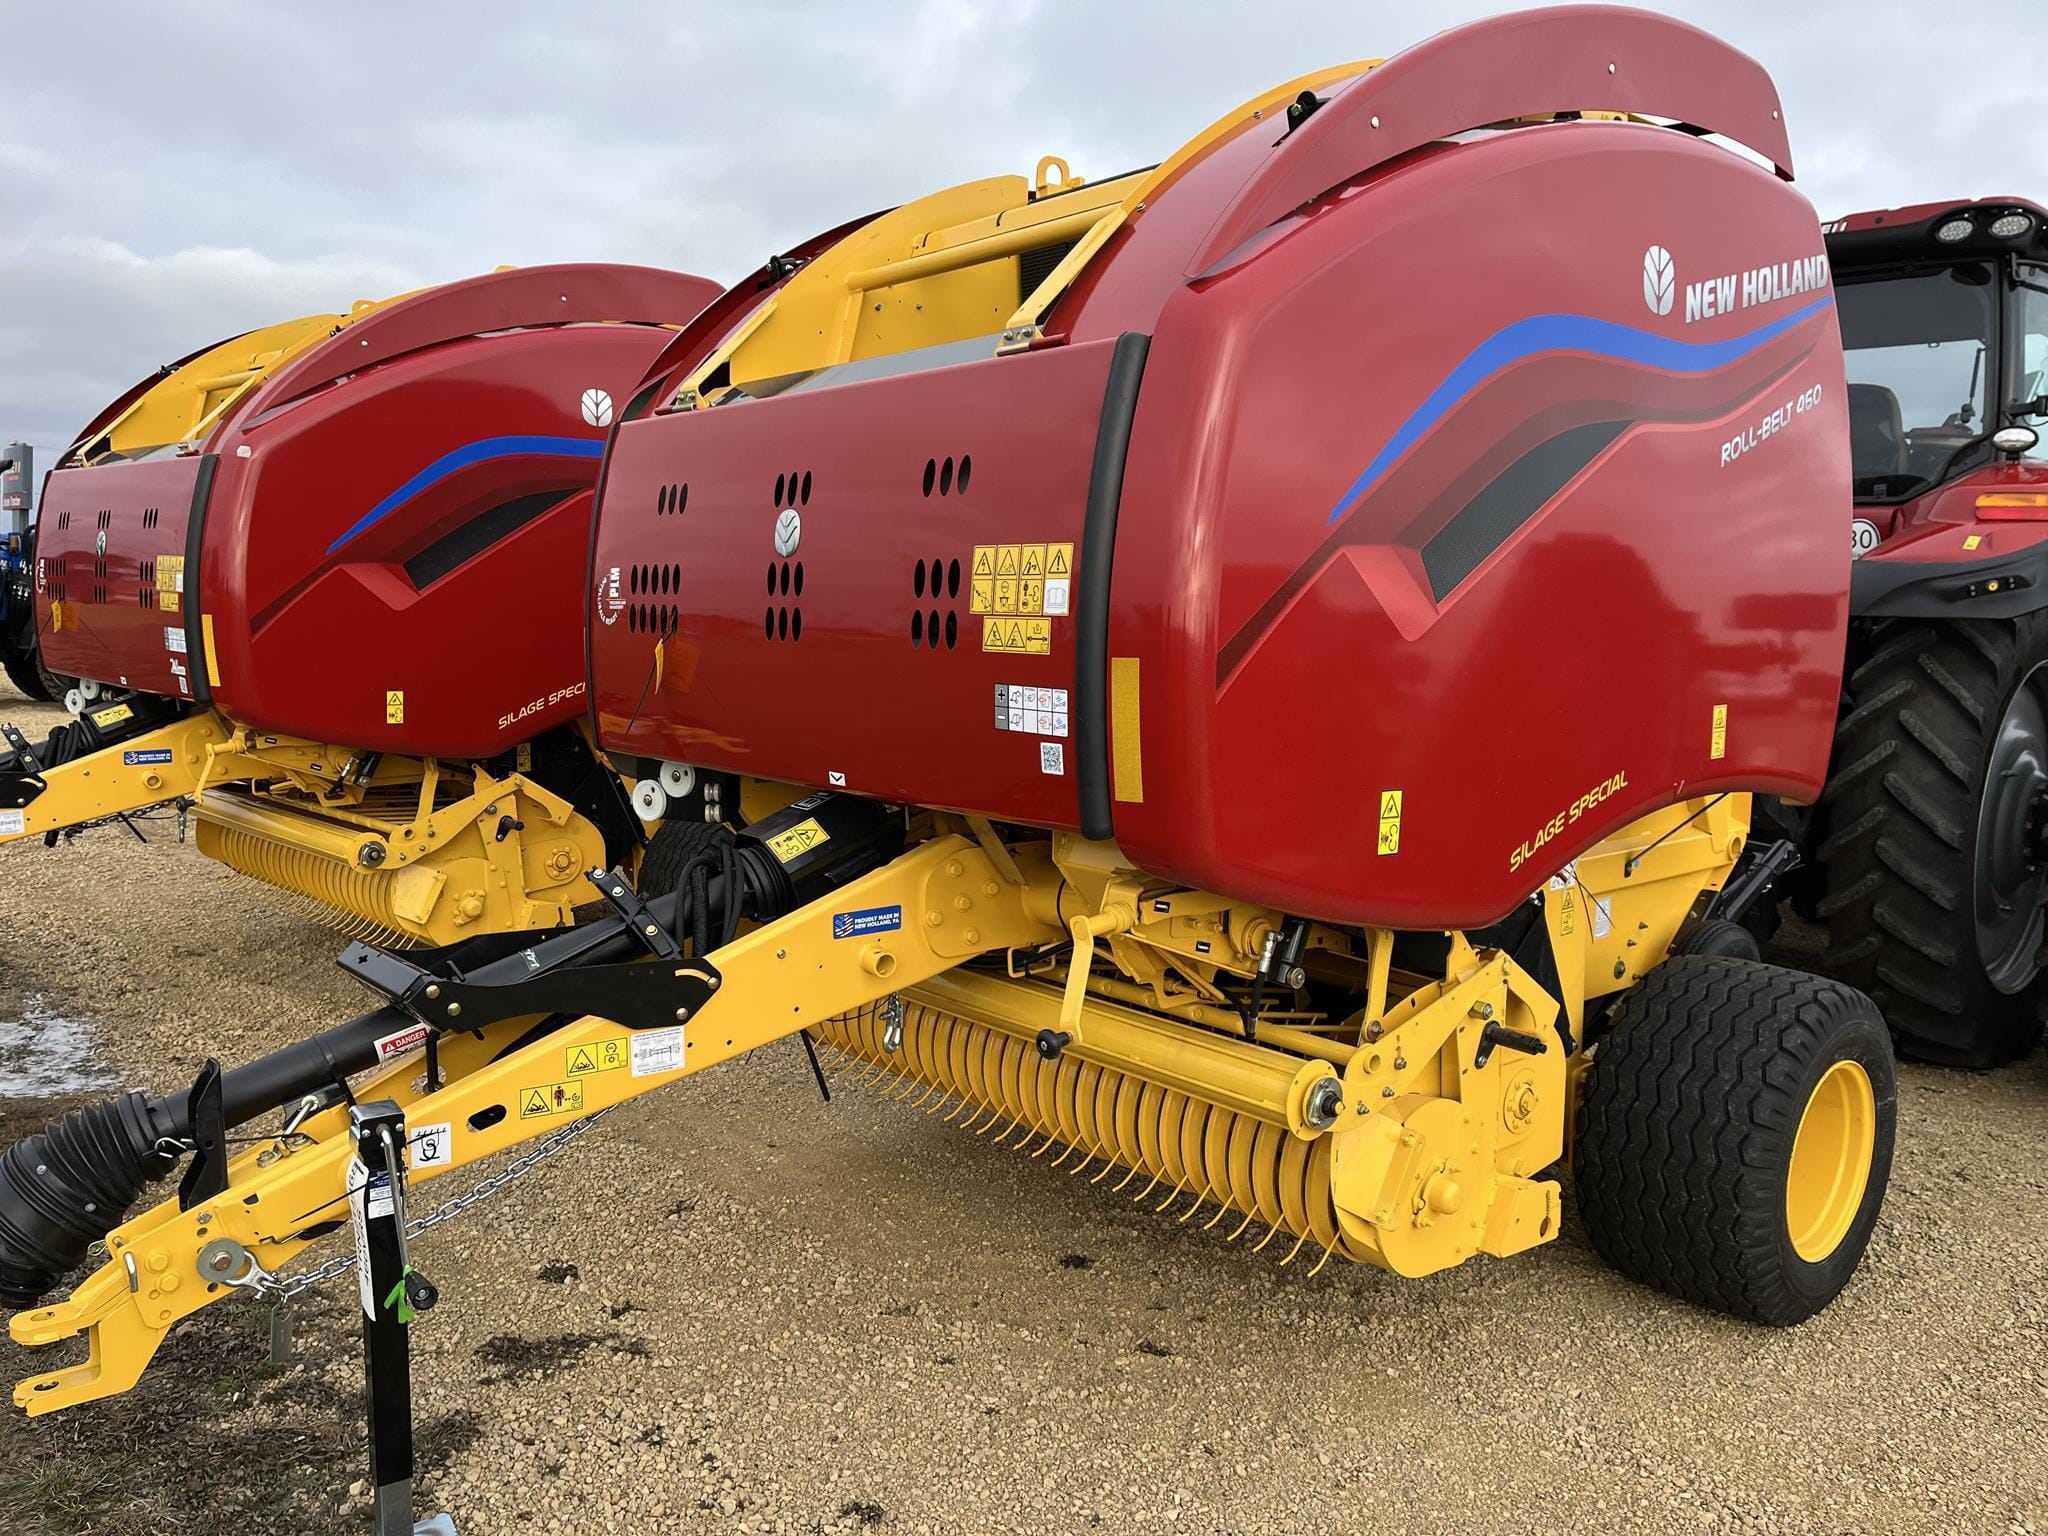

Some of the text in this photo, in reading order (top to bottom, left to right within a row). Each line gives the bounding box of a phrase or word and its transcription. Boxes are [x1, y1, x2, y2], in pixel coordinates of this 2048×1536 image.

[1685, 254, 1829, 324] NEW HOLLAND
[1720, 384, 1823, 467] ROLL-BELT 460
[609, 567, 620, 598] PLM
[498, 698, 545, 730] SILAGE
[1509, 770, 1629, 874] SILAGE SPECIAL
[854, 915, 878, 923] PROUDLY
[395, 1030, 426, 1047] DANGER
